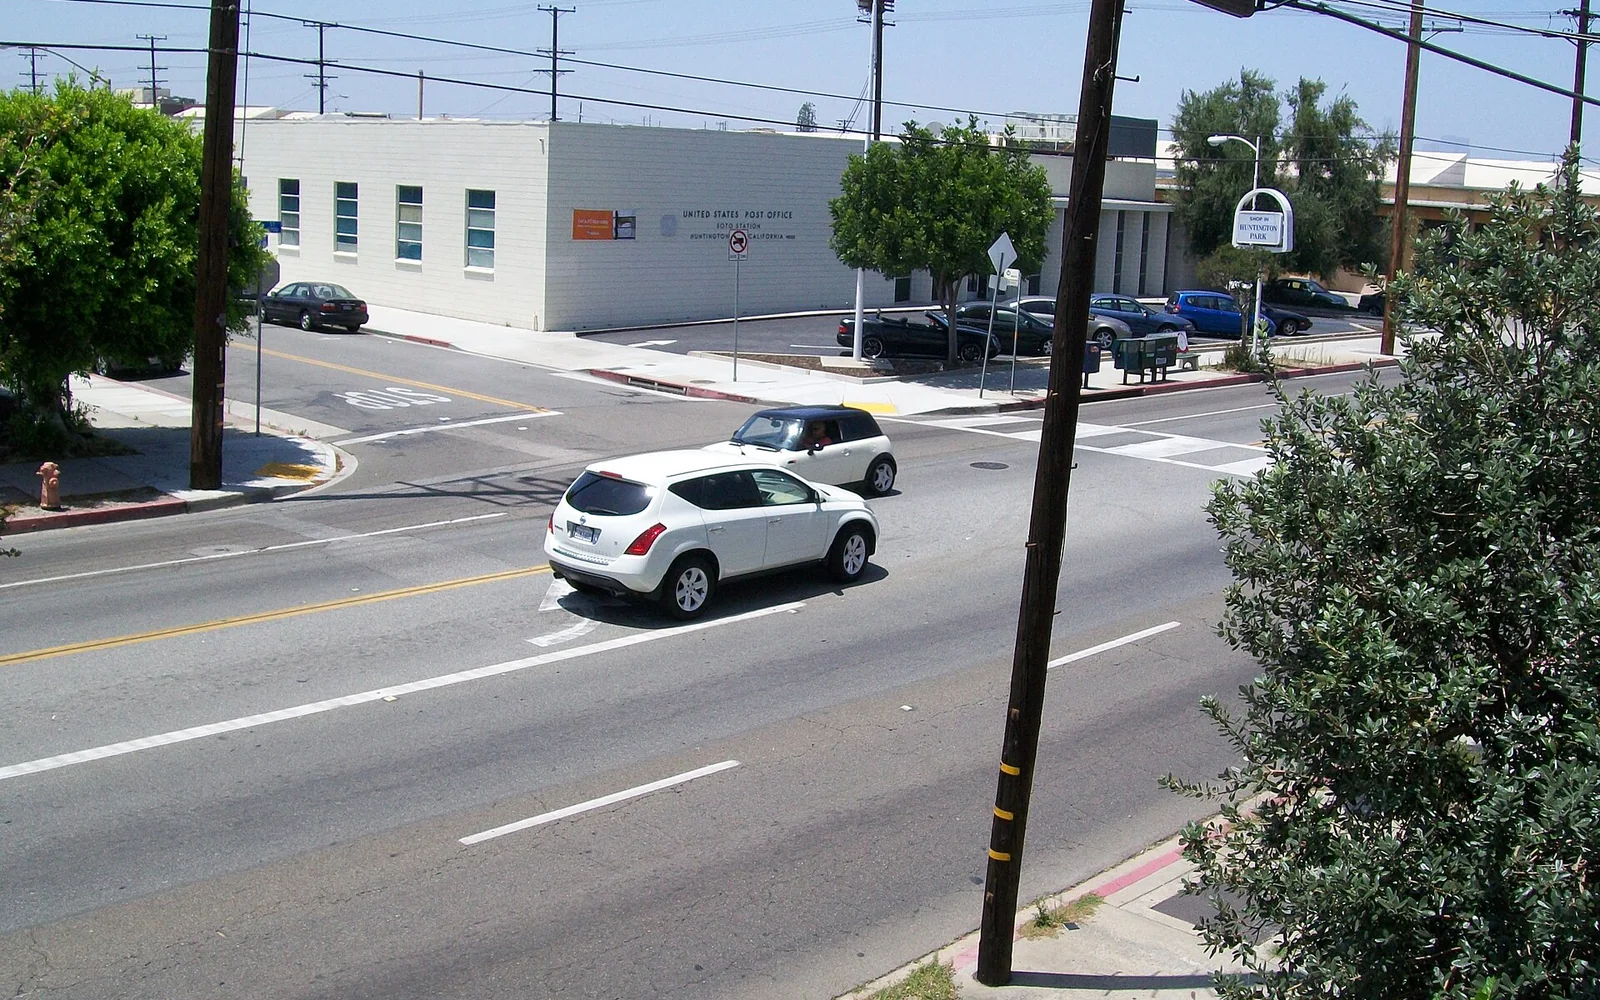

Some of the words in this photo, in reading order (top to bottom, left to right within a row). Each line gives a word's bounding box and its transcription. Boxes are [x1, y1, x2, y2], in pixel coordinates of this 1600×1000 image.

[683, 210, 710, 218] UNITED
[713, 210, 739, 218] STATES
[744, 211, 764, 219] POST
[767, 211, 793, 219] OFFICE
[331, 387, 452, 410] STOP
